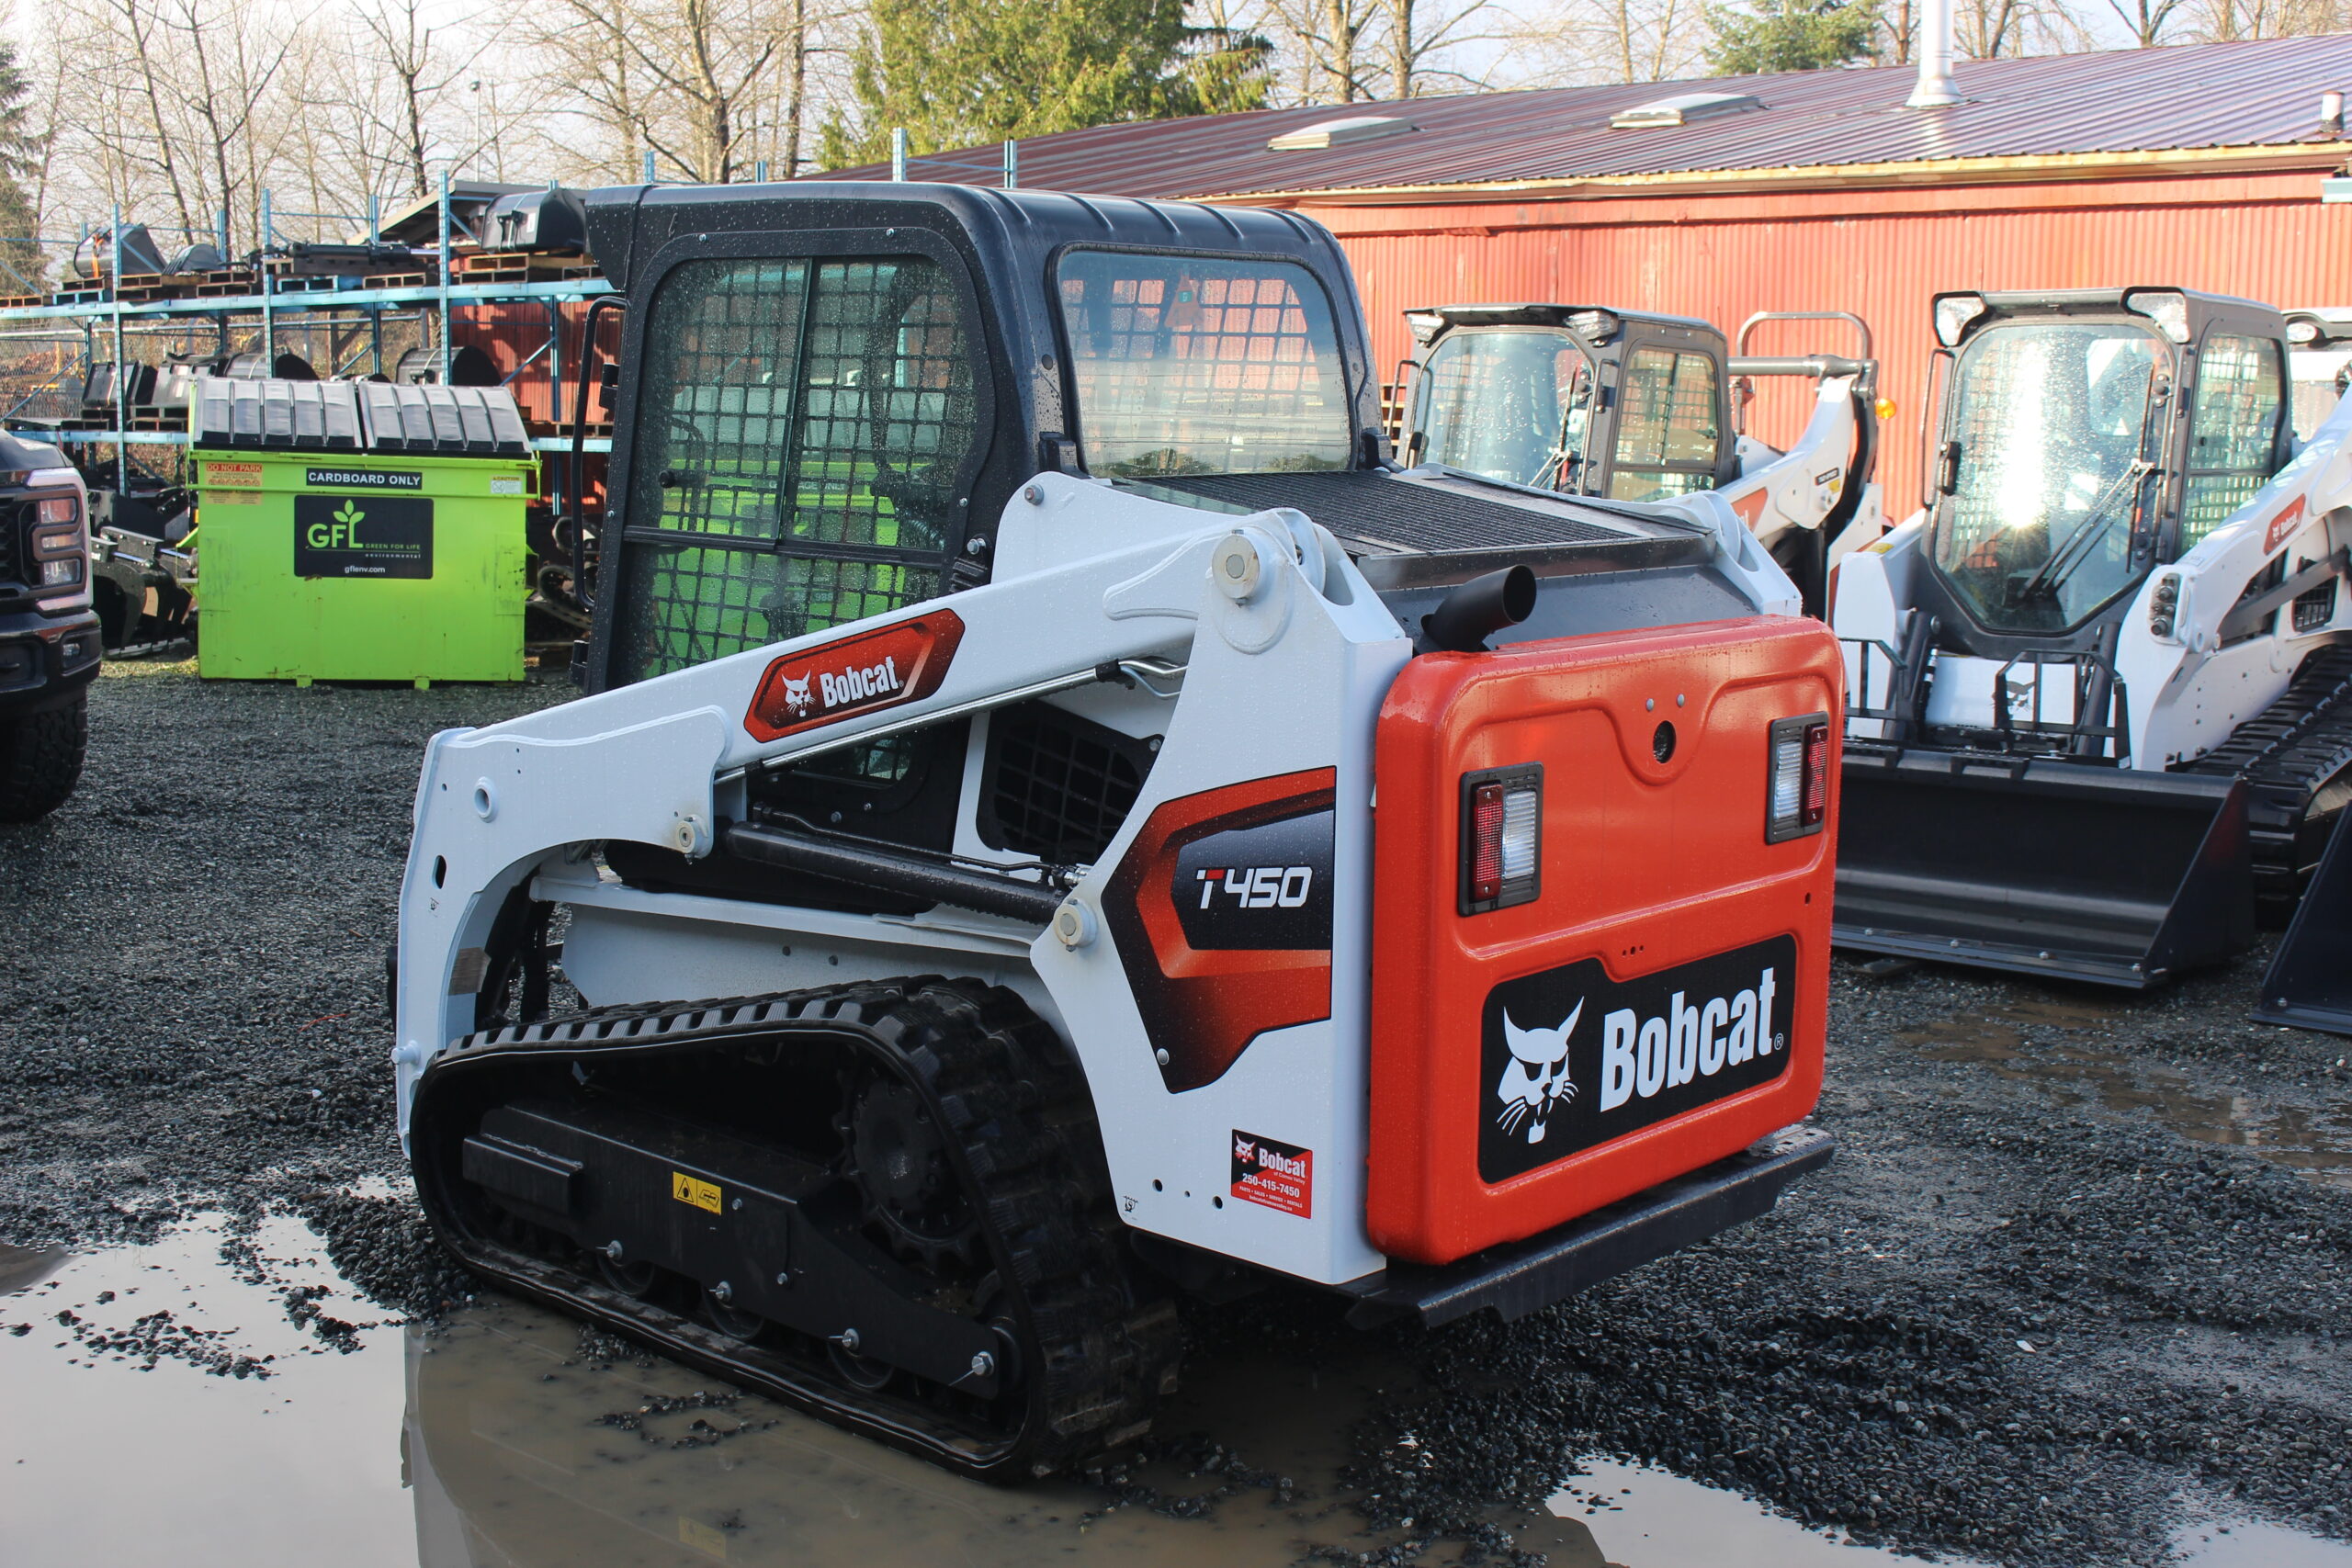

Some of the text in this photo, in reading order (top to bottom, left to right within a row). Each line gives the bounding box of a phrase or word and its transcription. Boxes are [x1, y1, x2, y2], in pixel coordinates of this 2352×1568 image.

[208, 463, 262, 472] DO NOT PARK
[309, 472, 421, 486] CARDBOARD ONLY
[307, 515, 364, 548] GFL
[345, 565, 386, 574] gflenv.com
[820, 656, 899, 708] Bobcat
[1196, 866, 1313, 909] T450
[1600, 967, 1776, 1113] Bobcat
[1259, 1147, 1306, 1179] Bobcat
[1242, 1172, 1300, 1198] 250-415-7450
[1286, 1200, 1303, 1208] RENTALS
